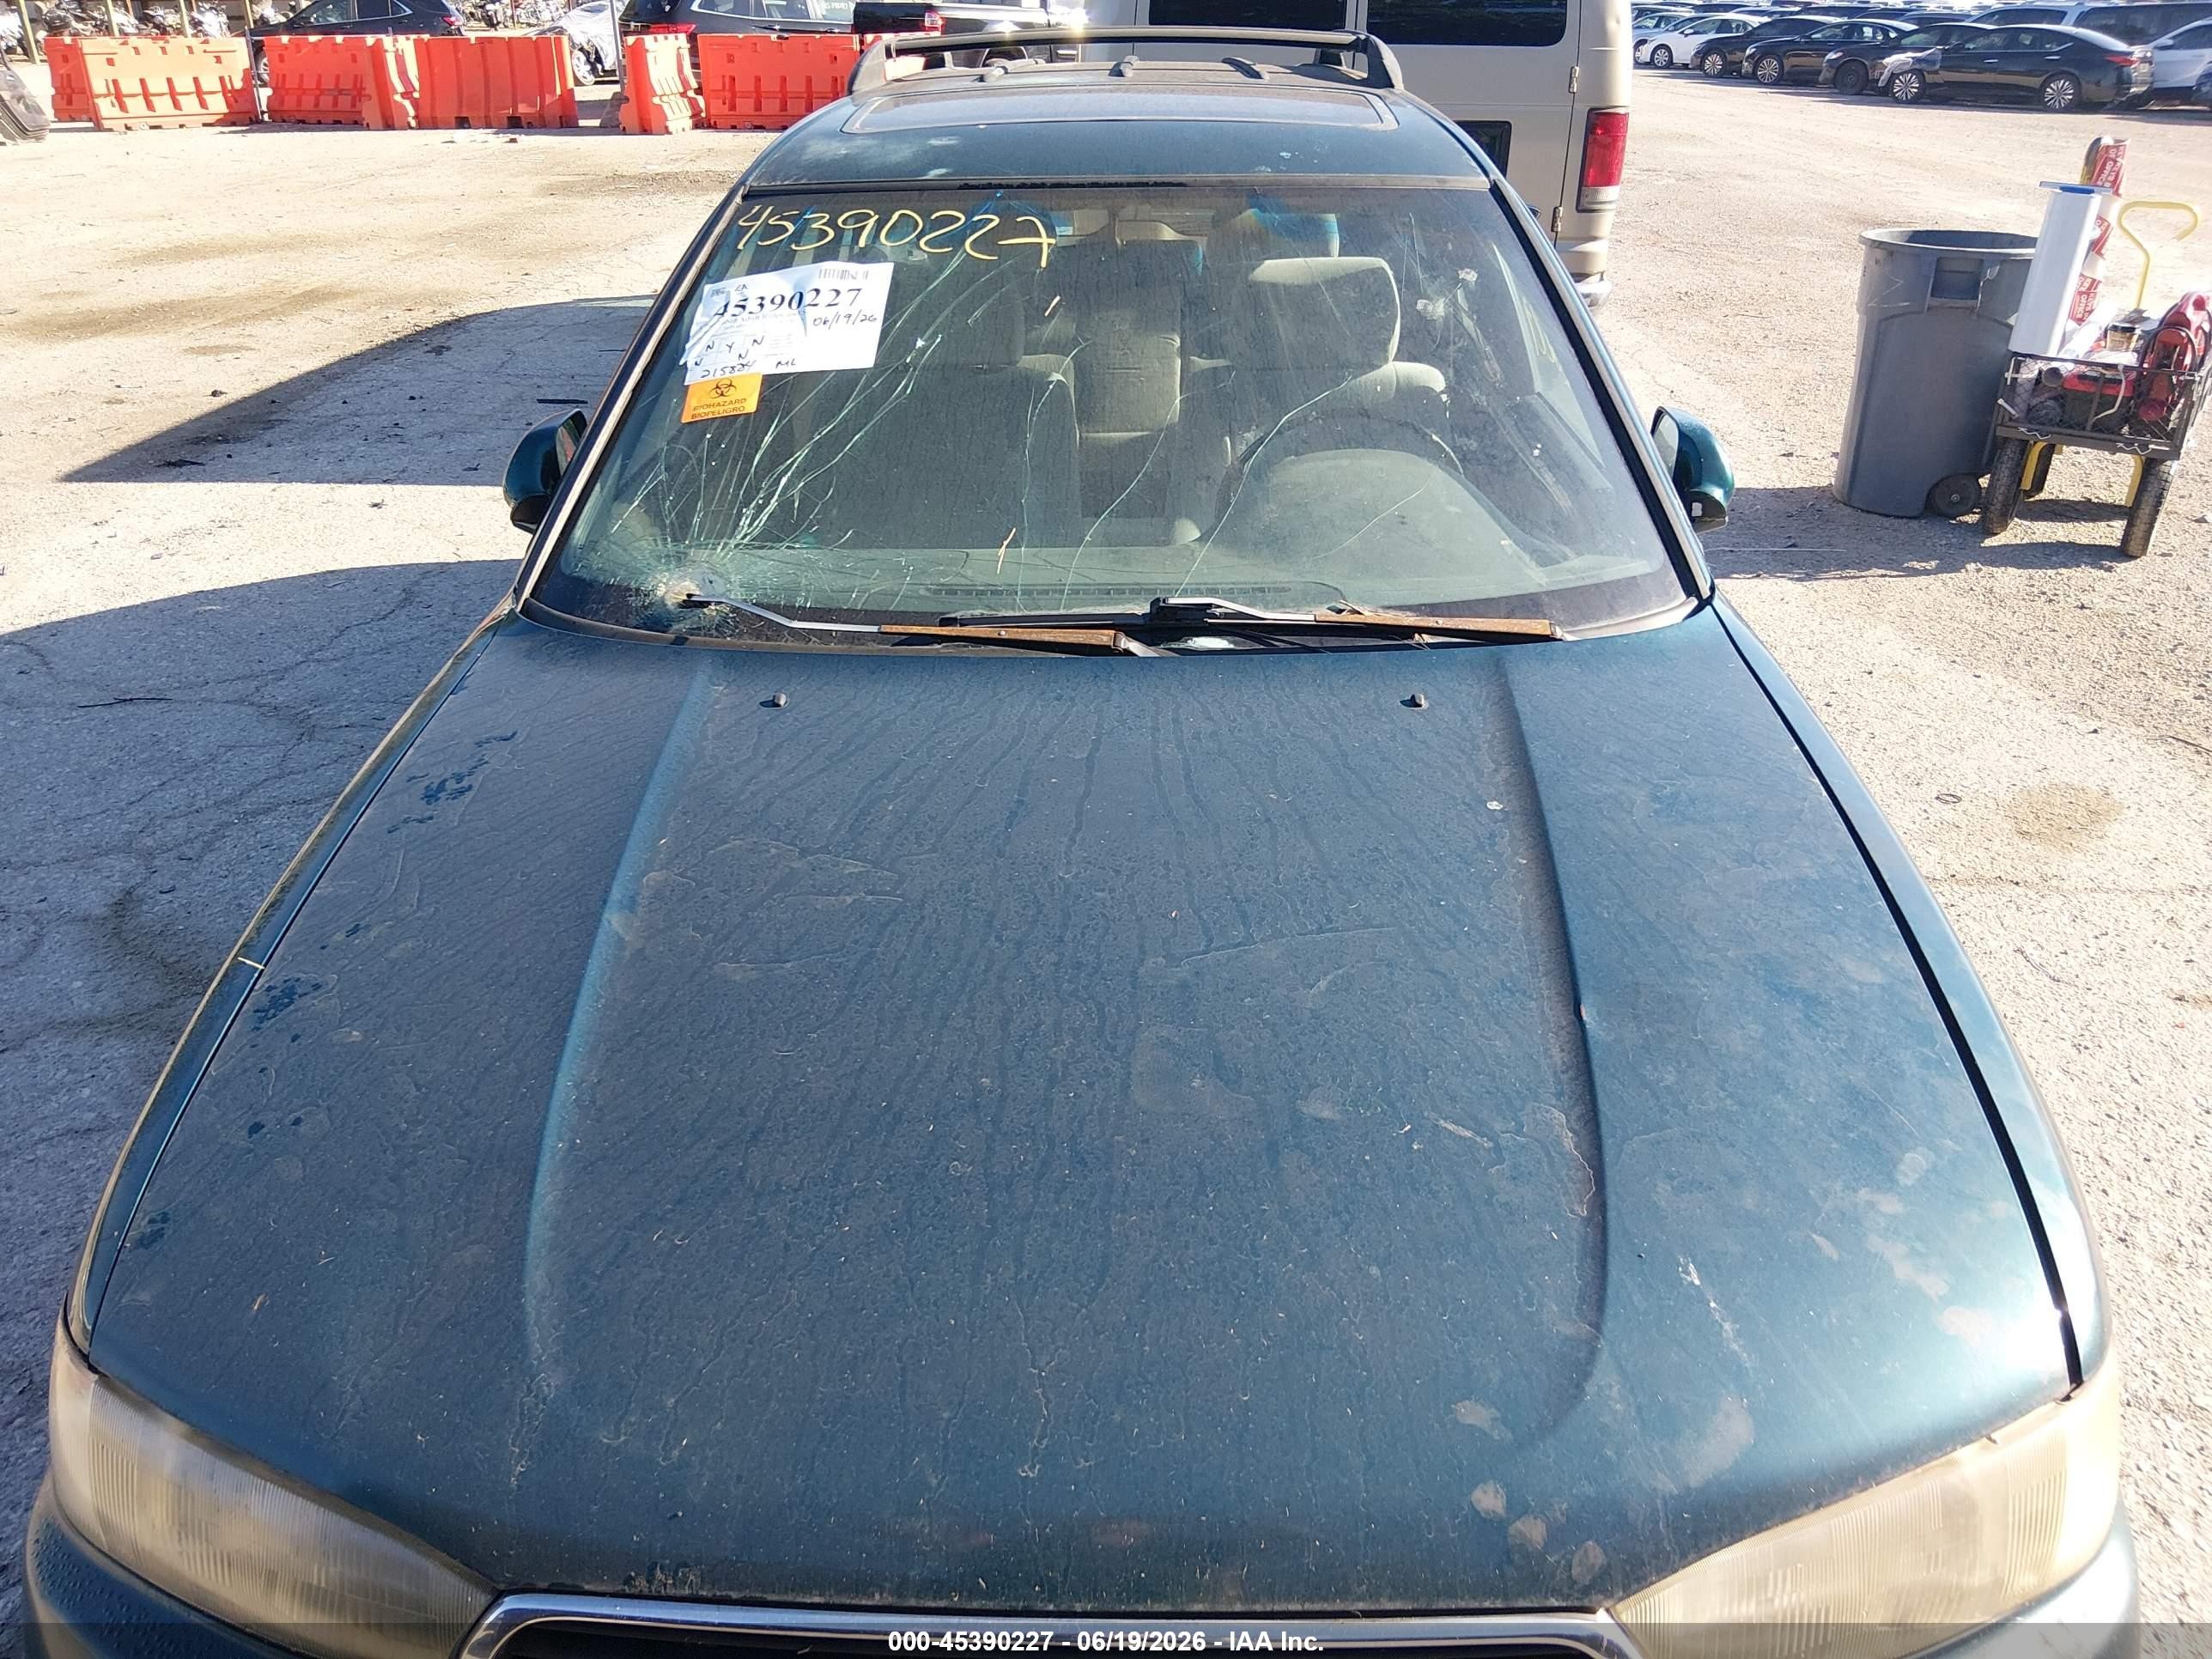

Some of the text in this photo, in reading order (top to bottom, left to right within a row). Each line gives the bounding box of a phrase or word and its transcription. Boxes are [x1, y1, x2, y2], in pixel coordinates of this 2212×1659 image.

[737, 205, 1056, 269] 45390227
[714, 288, 863, 317] 45390227
[2075, 294, 2087, 319] OFFICE
[690, 406, 745, 420] BIOPELIGRO
[693, 398, 747, 411] BIOHAZARD
